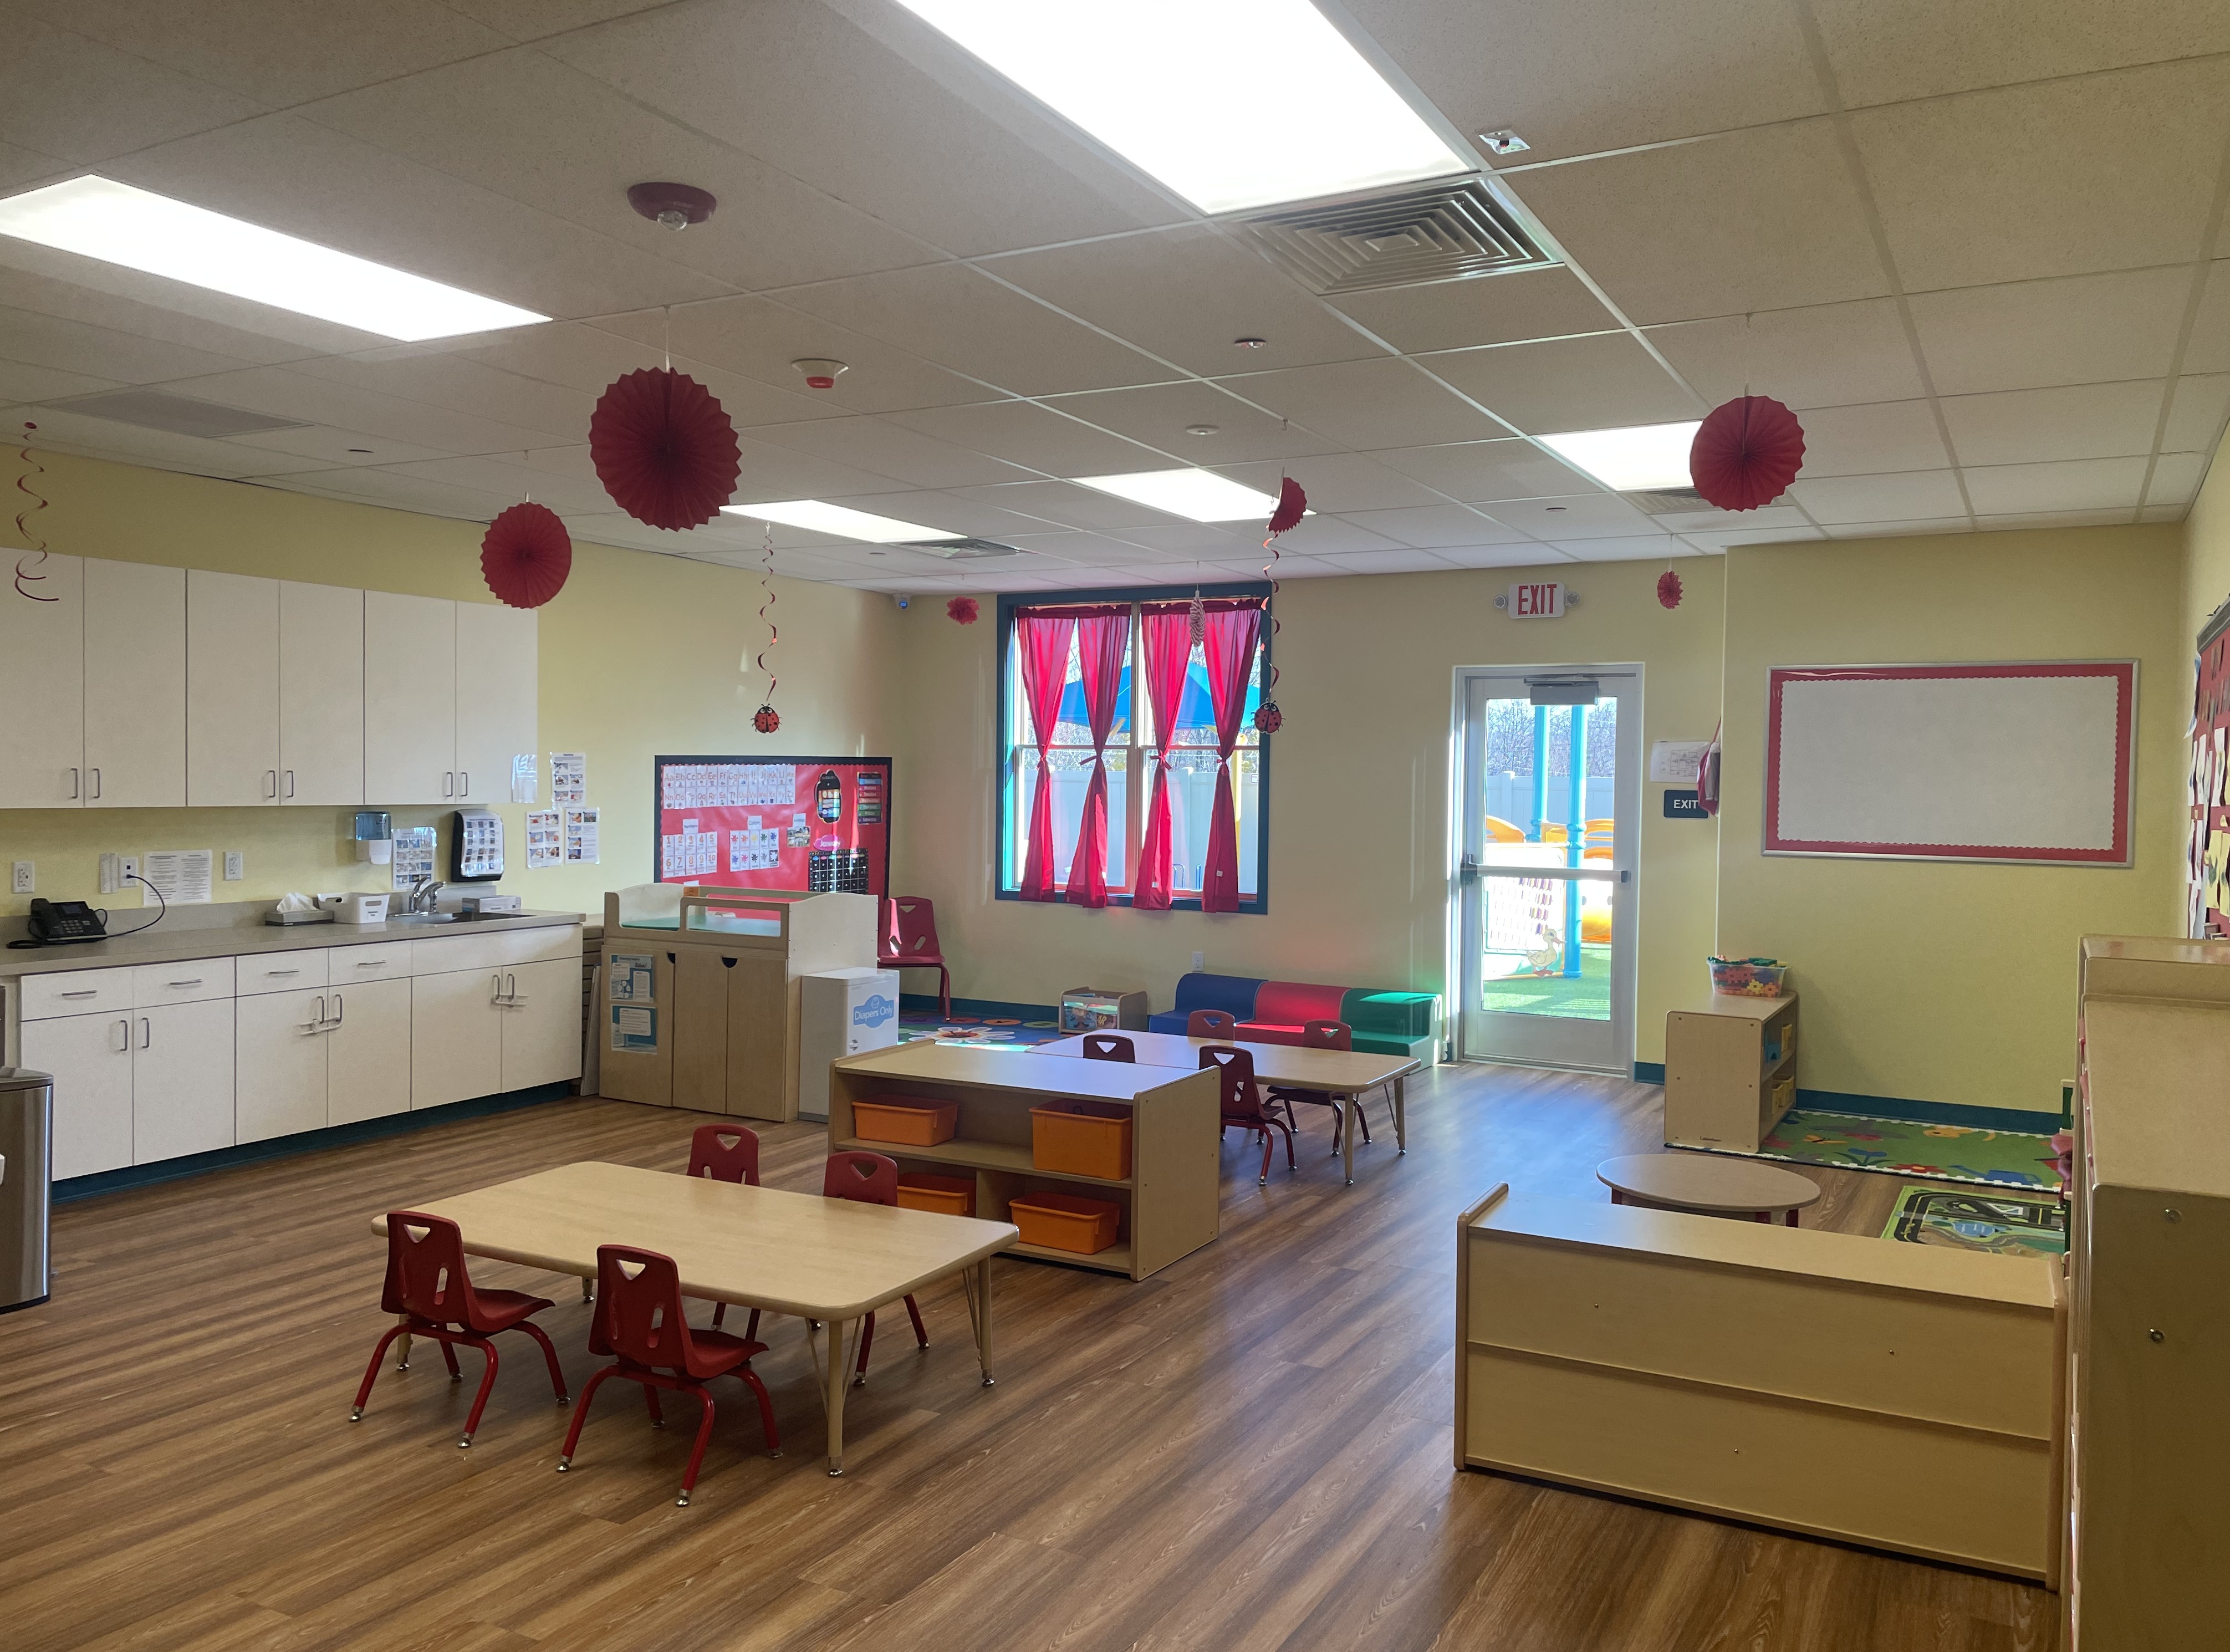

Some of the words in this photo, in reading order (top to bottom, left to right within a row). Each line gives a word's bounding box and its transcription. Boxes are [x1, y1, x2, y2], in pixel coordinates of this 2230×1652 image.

[1518, 584, 1557, 615] EXIT
[676, 773, 685, 781] Bb
[708, 772, 716, 780] Ee
[728, 772, 738, 782] Gg
[1673, 799, 1699, 809] EXIT
[666, 835, 671, 844] 1
[699, 834, 704, 843] 4
[710, 834, 714, 842] 5
[666, 858, 671, 867] 6
[677, 856, 682, 865] 7
[688, 855, 693, 865] 8
[699, 854, 704, 863] 9
[854, 1009, 879, 1022] Diapers
[880, 1005, 893, 1017] Only
